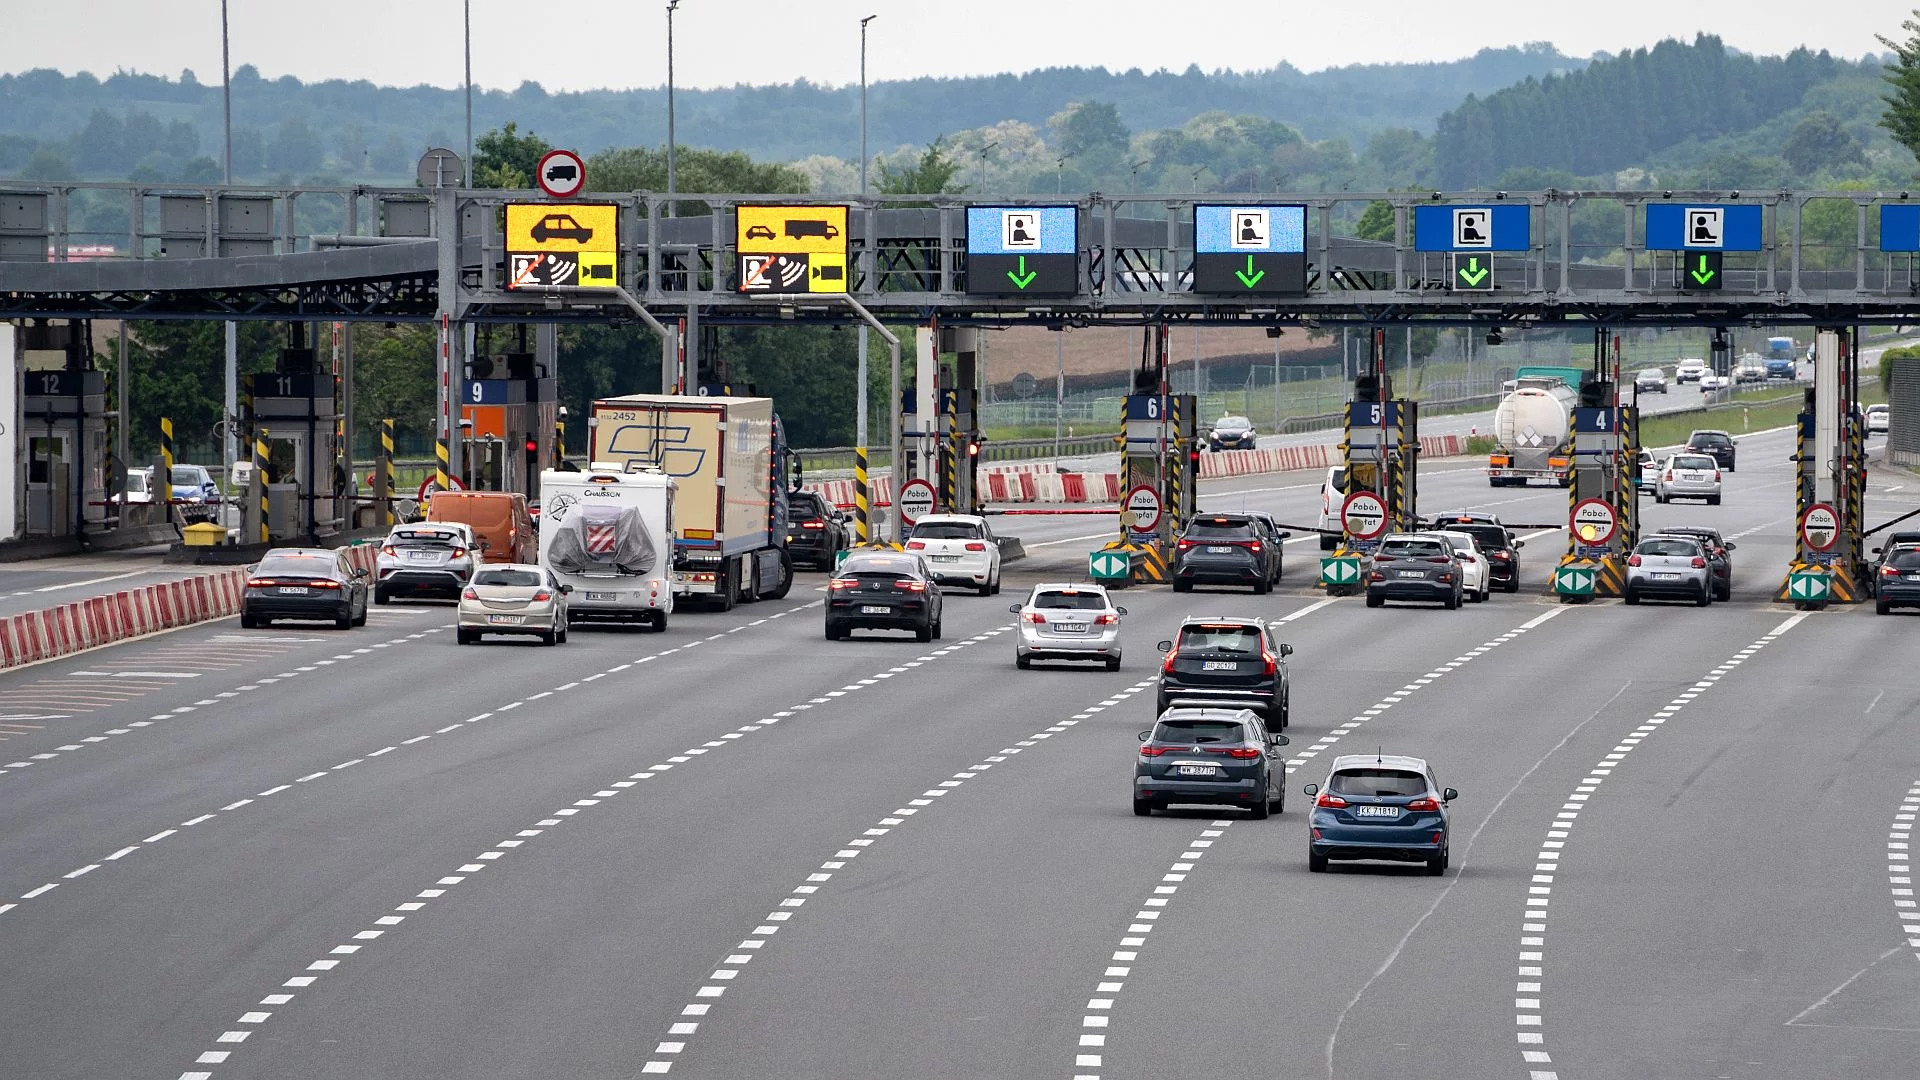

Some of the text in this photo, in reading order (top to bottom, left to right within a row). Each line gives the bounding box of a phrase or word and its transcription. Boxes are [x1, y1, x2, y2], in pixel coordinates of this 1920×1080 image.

[41, 374, 60, 394] 12
[276, 376, 291, 395] 11
[472, 382, 482, 402] 9
[612, 411, 637, 421] 2452
[1147, 397, 1158, 418] 6
[1371, 404, 1380, 424] 5
[1595, 410, 1607, 430] 4
[1361, 806, 1397, 815] KK 71818
